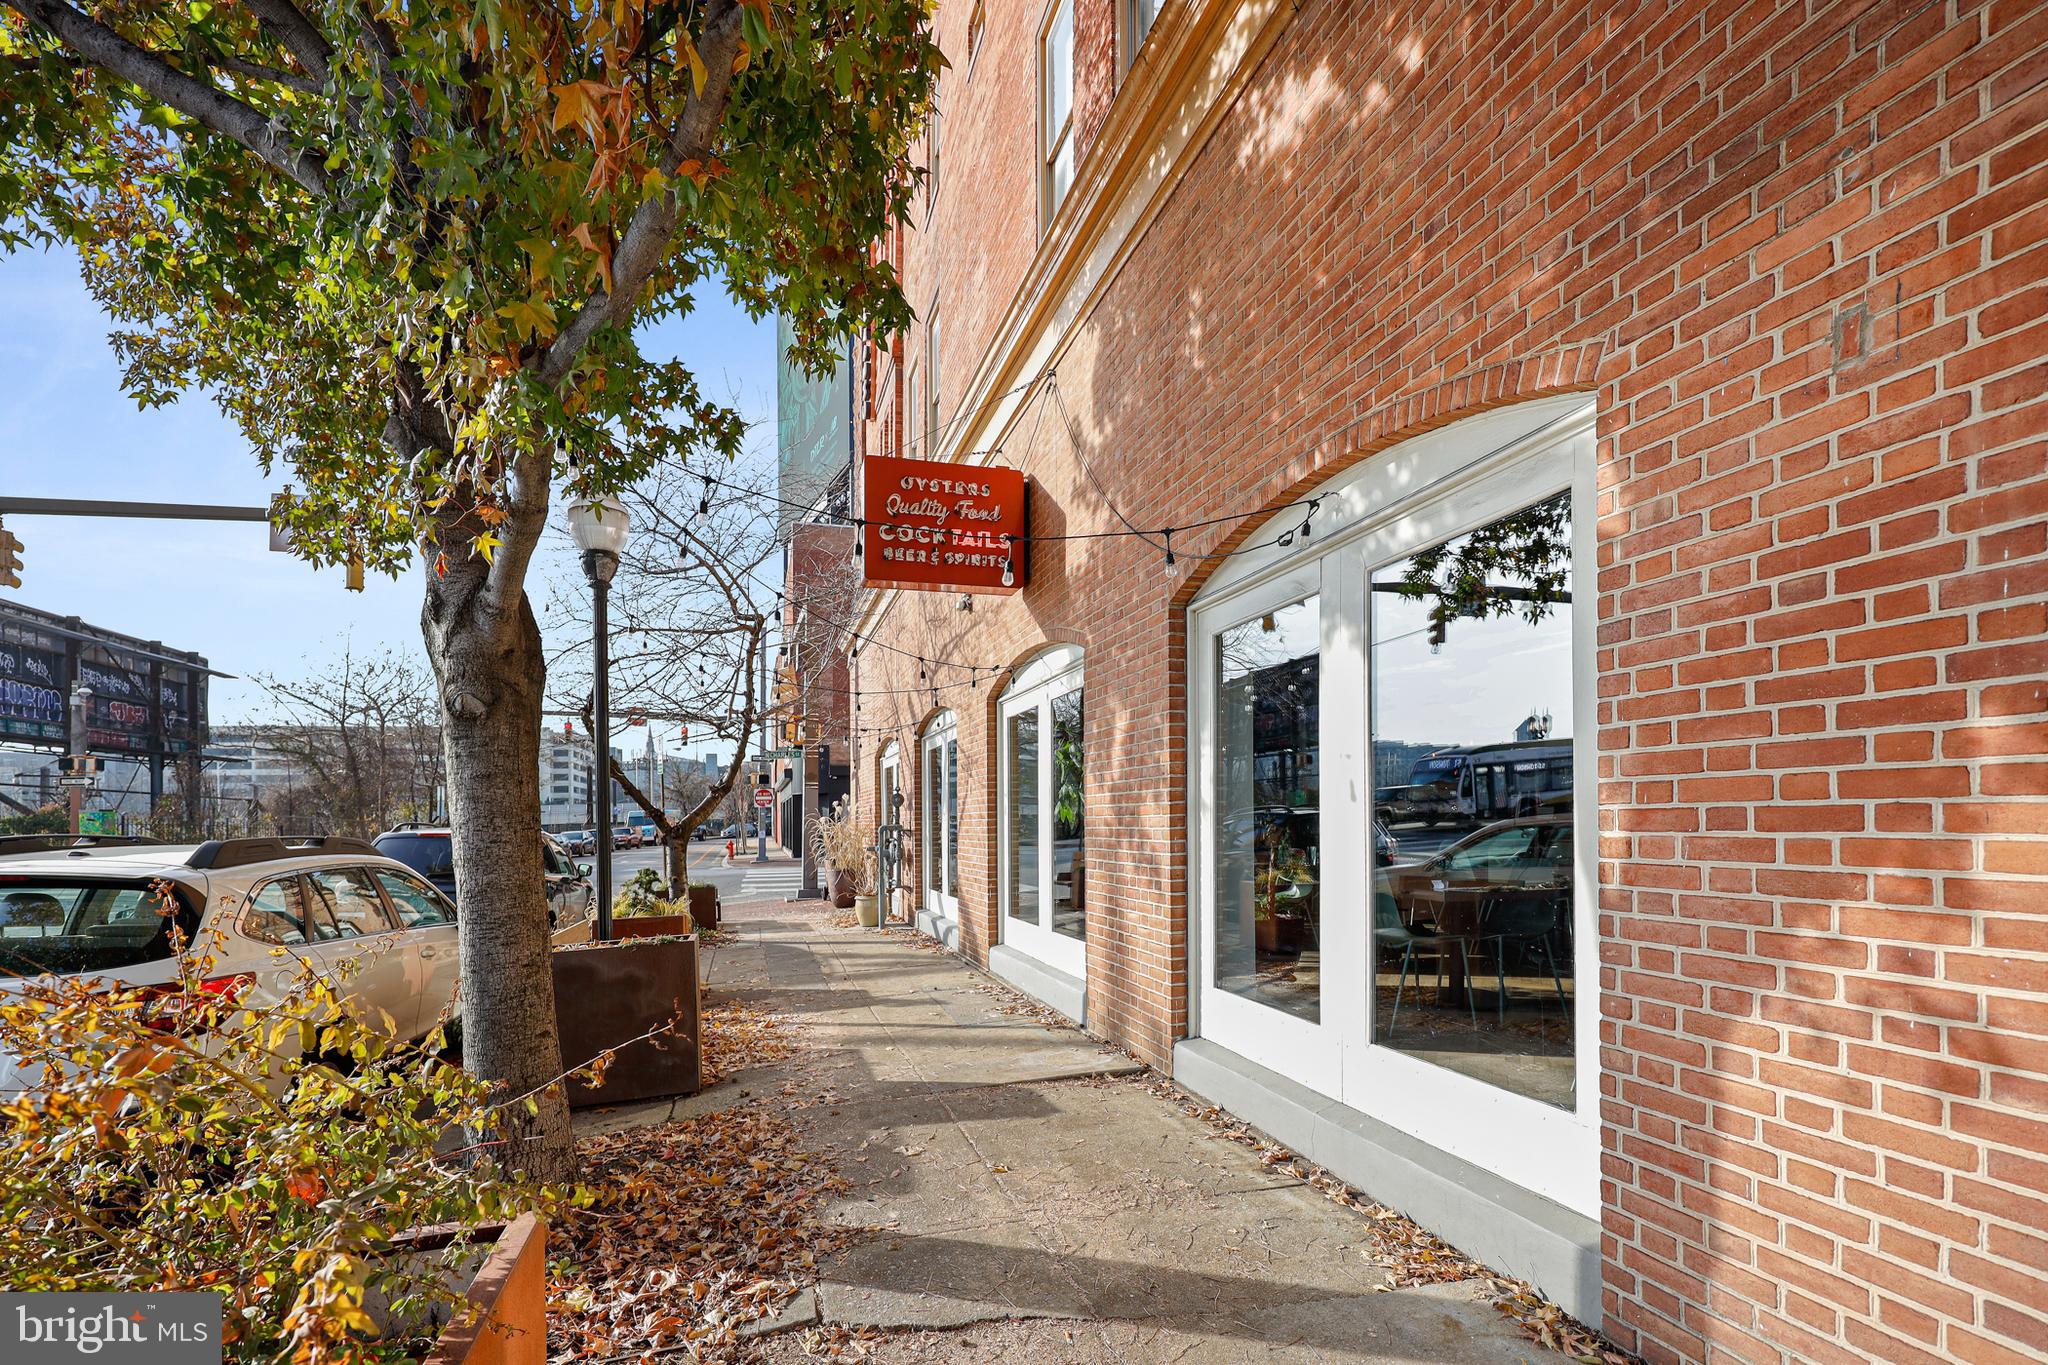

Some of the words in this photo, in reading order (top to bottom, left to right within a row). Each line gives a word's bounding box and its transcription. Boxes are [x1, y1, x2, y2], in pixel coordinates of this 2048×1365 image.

[900, 475, 991, 497] OYSTERS
[886, 493, 950, 525] Quality
[954, 499, 1002, 522] Food
[883, 546, 928, 562] BEER
[931, 547, 940, 566] &
[944, 552, 1006, 568] SPIRITS
